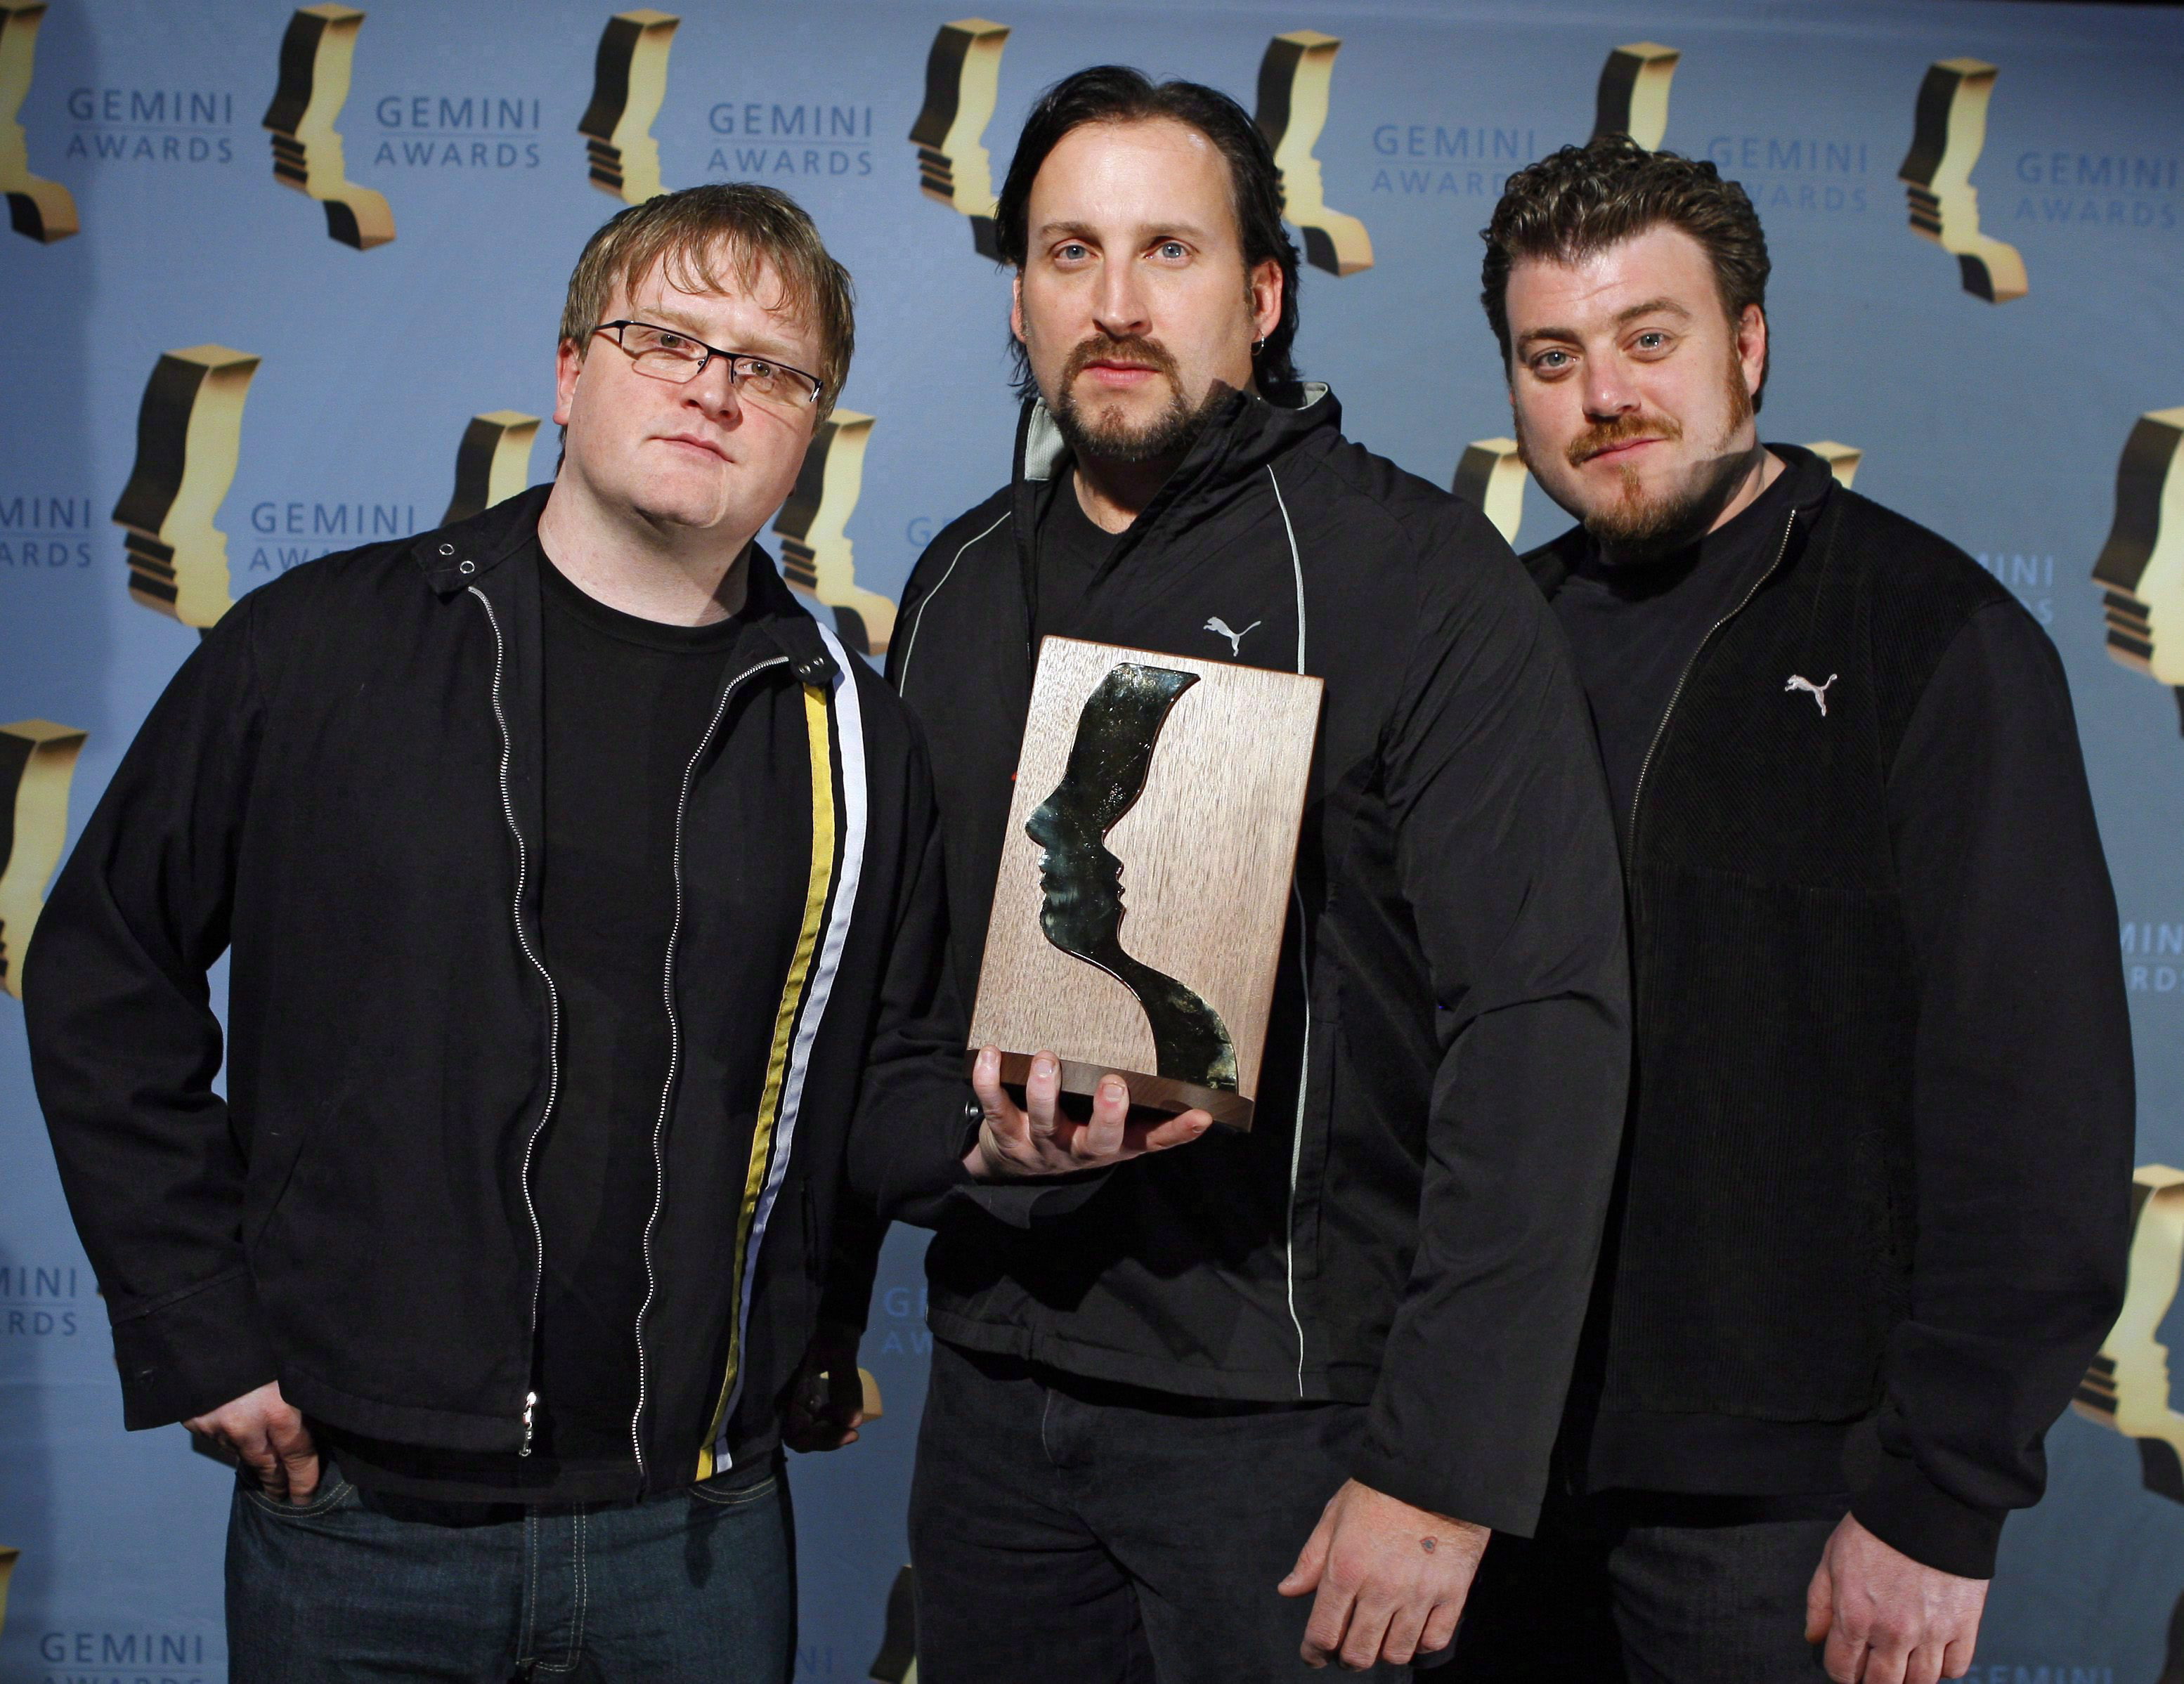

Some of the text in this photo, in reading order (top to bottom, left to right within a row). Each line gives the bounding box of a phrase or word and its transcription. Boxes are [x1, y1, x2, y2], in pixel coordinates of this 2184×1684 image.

[68, 88, 232, 123] GEMINI
[376, 96, 540, 129] GEMINI
[708, 103, 871, 136] GEMINI
[67, 133, 232, 164] AWARDS
[374, 142, 540, 169] AWARDS
[1373, 124, 1535, 159] GEMINI
[1708, 137, 1866, 173] GEMINI
[707, 149, 871, 176] AWARDS
[2015, 152, 2176, 188] GEMINI
[1372, 169, 1506, 197] AWARD
[2014, 197, 2176, 229] AWARDS
[0, 497, 91, 528] MINI
[251, 502, 415, 535] GEMINI
[0, 541, 91, 568] ARDS
[8, 1310, 77, 1336] RDS
[40, 1631, 202, 1664] GEMINI
